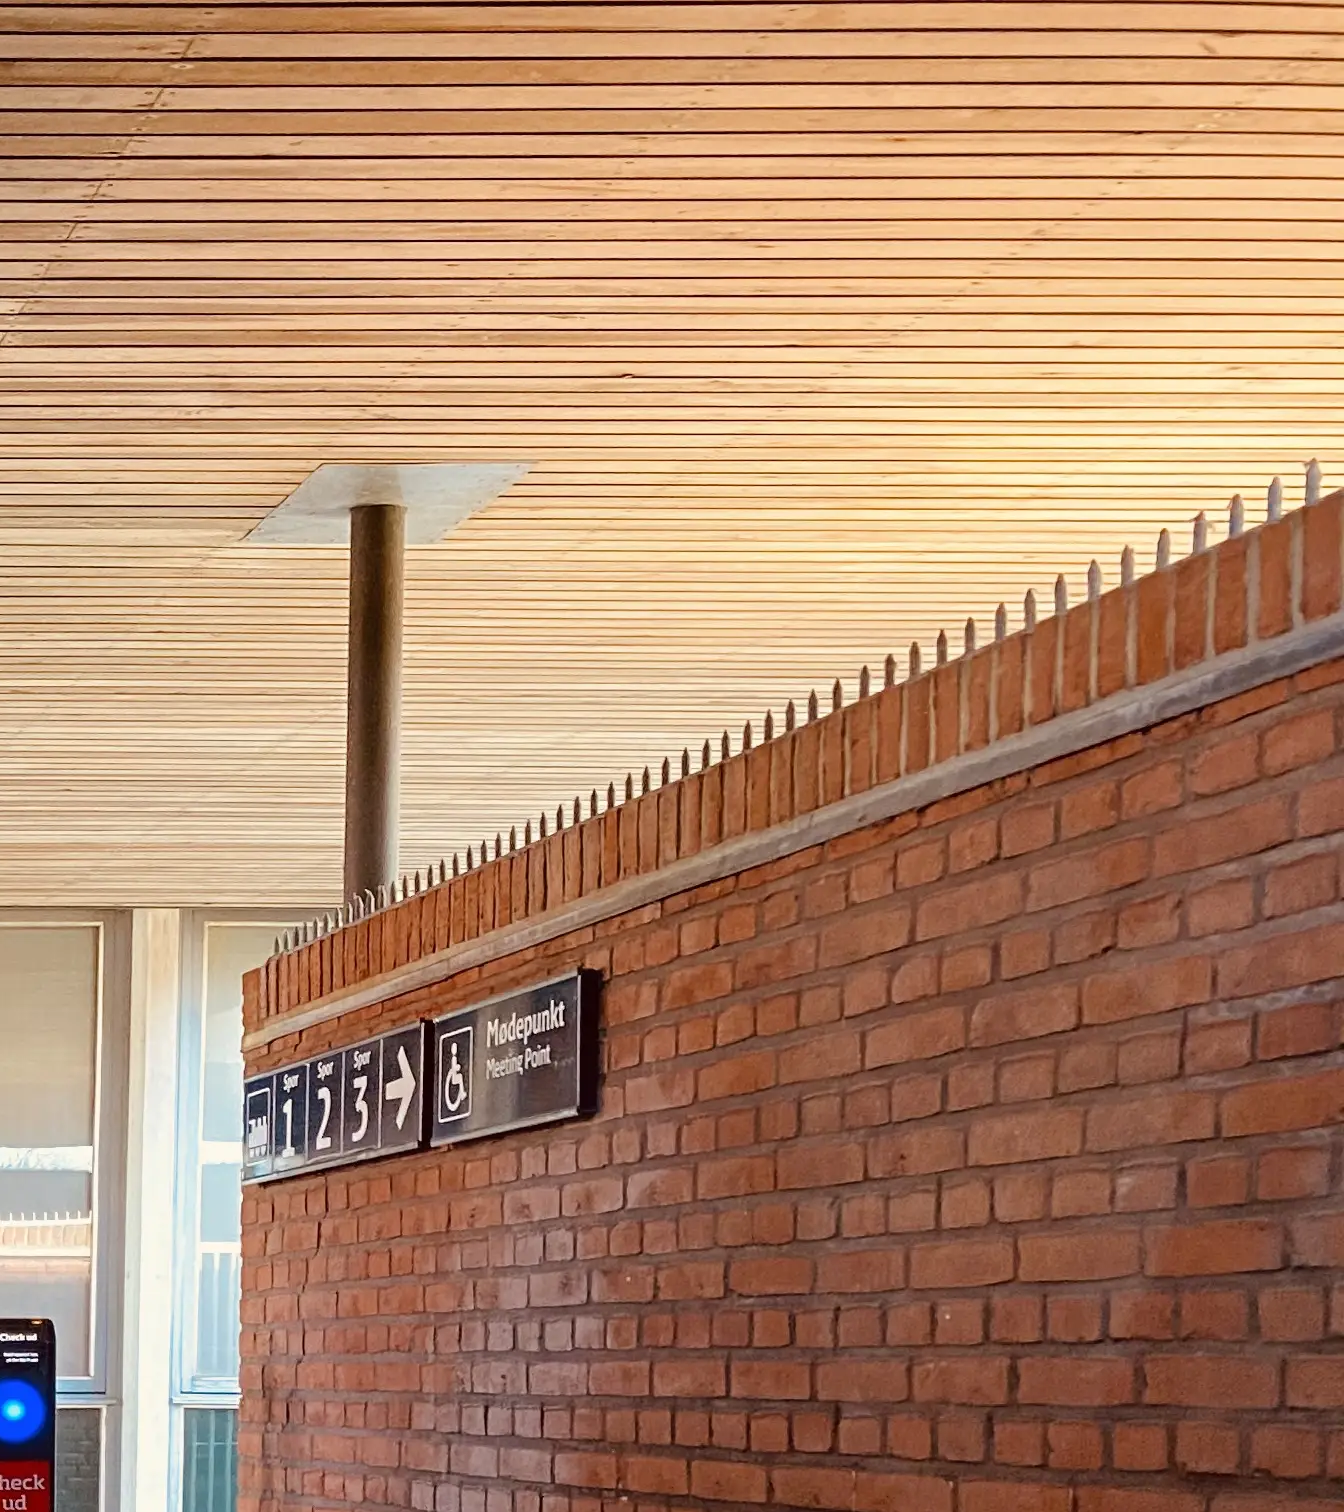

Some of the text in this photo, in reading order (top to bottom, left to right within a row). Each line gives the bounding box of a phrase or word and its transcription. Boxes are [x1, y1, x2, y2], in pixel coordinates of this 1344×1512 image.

[486, 999, 566, 1049] Mødepunkt
[283, 1049, 371, 1091] Spor Spor Spor
[486, 1044, 552, 1080] Meeting Point
[281, 1075, 369, 1158] 1 2 3
[2, 1495, 28, 1511] ud
